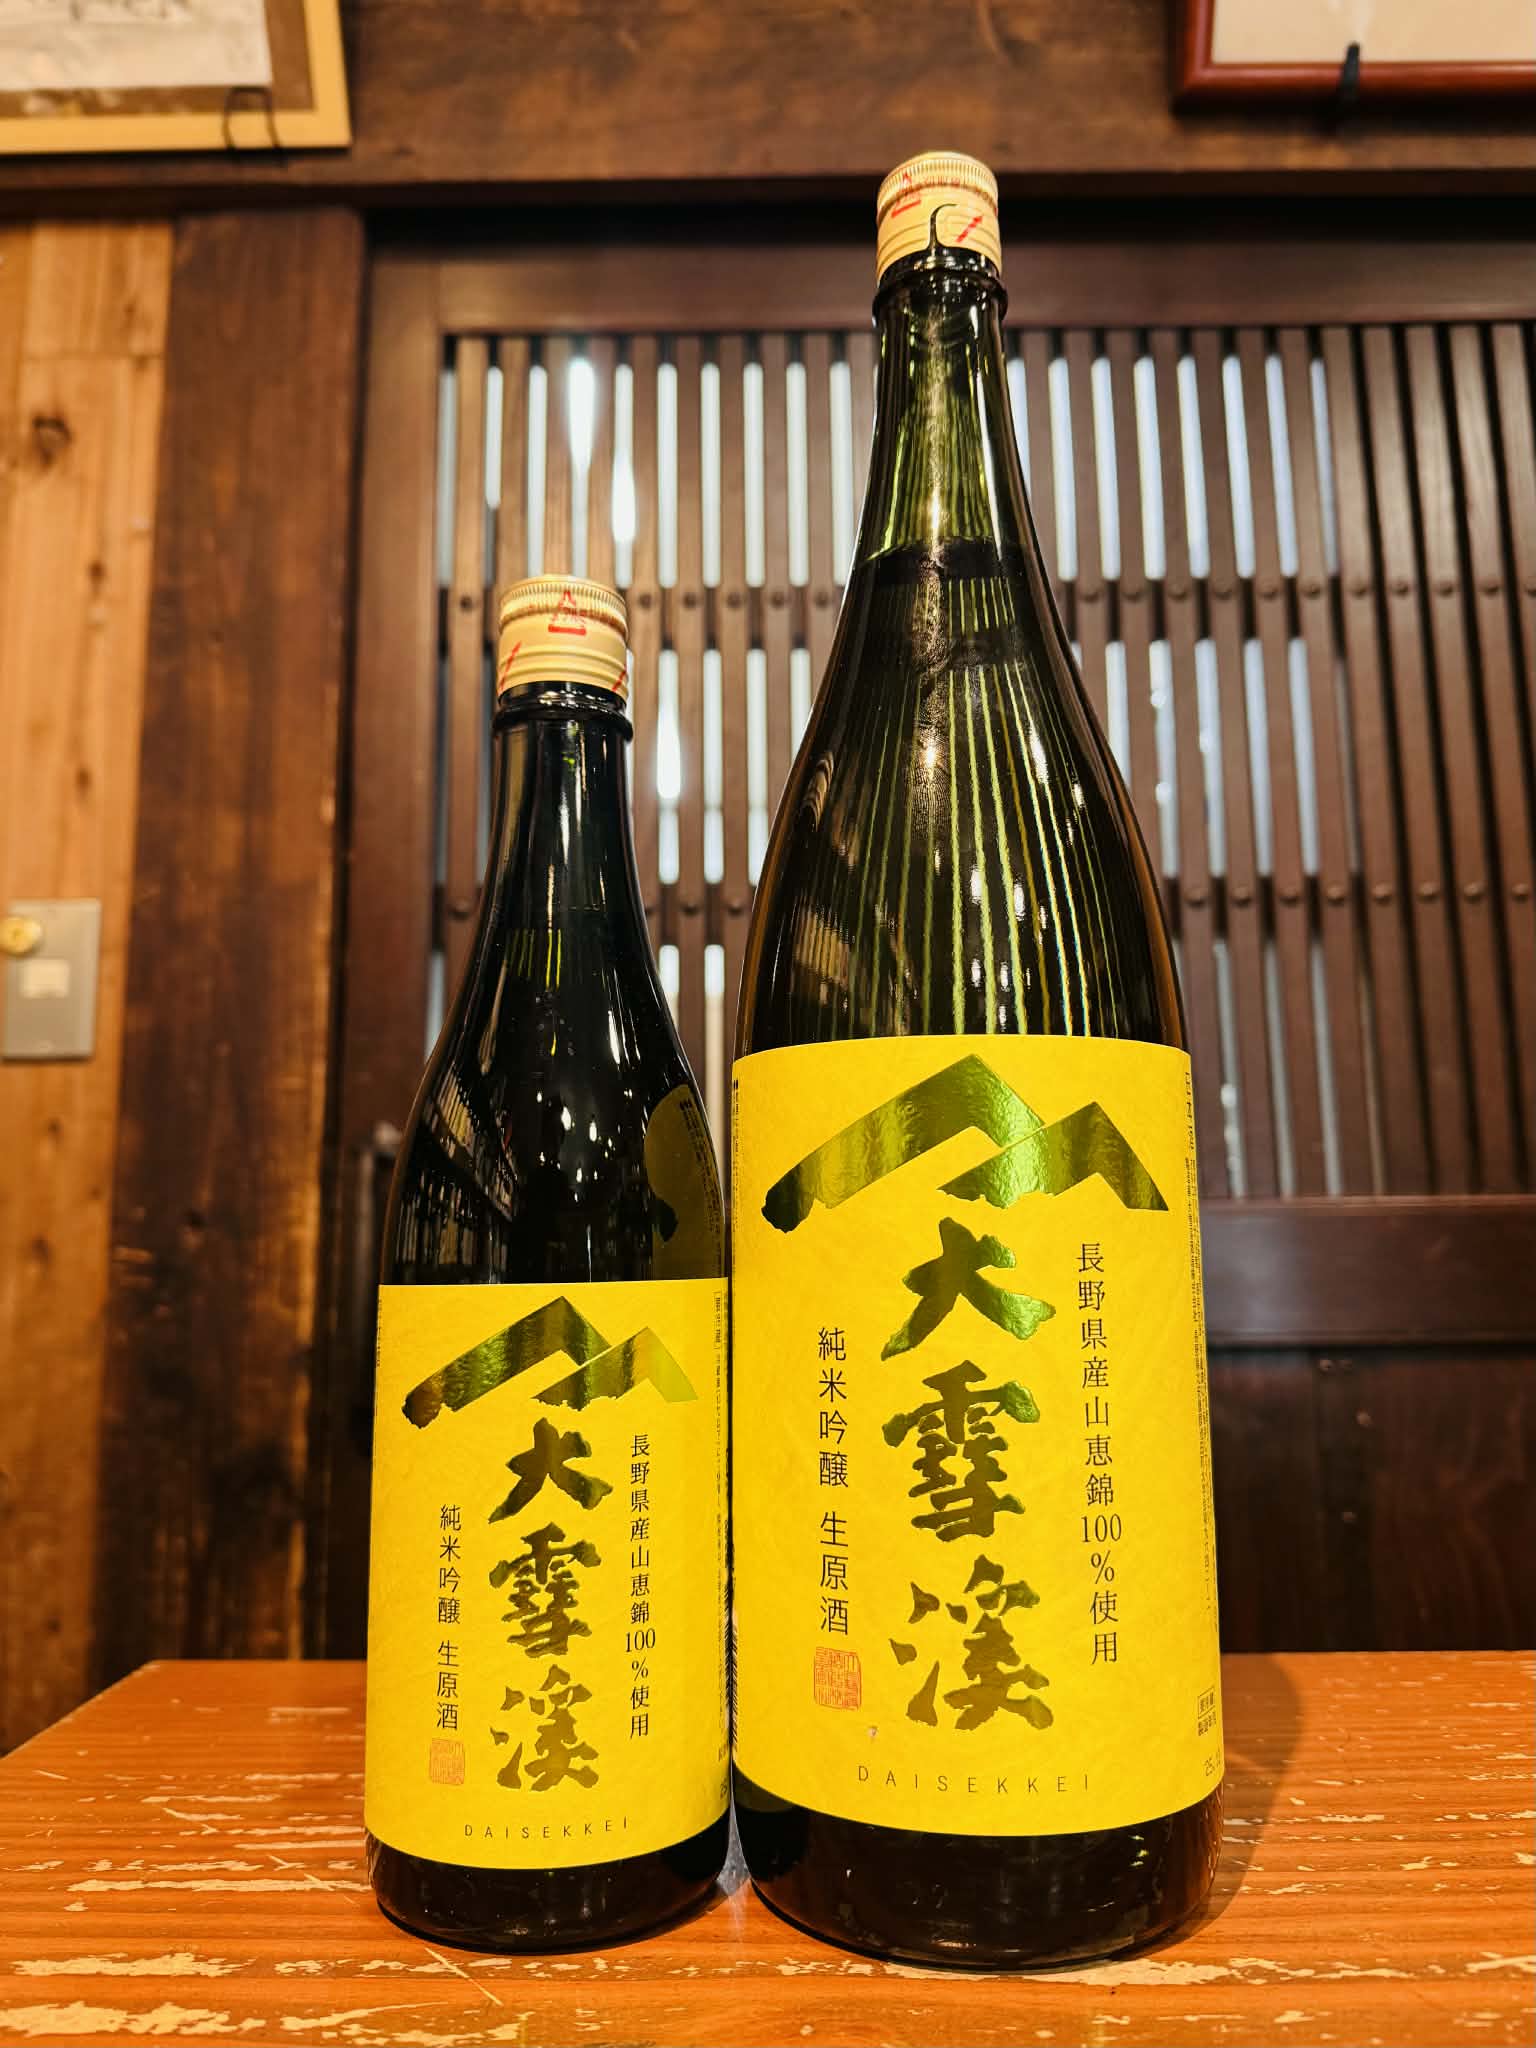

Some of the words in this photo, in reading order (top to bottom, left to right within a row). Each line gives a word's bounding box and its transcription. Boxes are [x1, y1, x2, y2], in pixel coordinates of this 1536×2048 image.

[818, 1327, 849, 1488] 純米吟醸
[438, 1504, 462, 1624] 純米吟醸
[819, 1511, 849, 1636] 生原酒
[436, 1639, 459, 1730] 生原酒
[464, 1816, 629, 1840] DAISEKKEI
[857, 1765, 1090, 1794] DAISEKKEI
